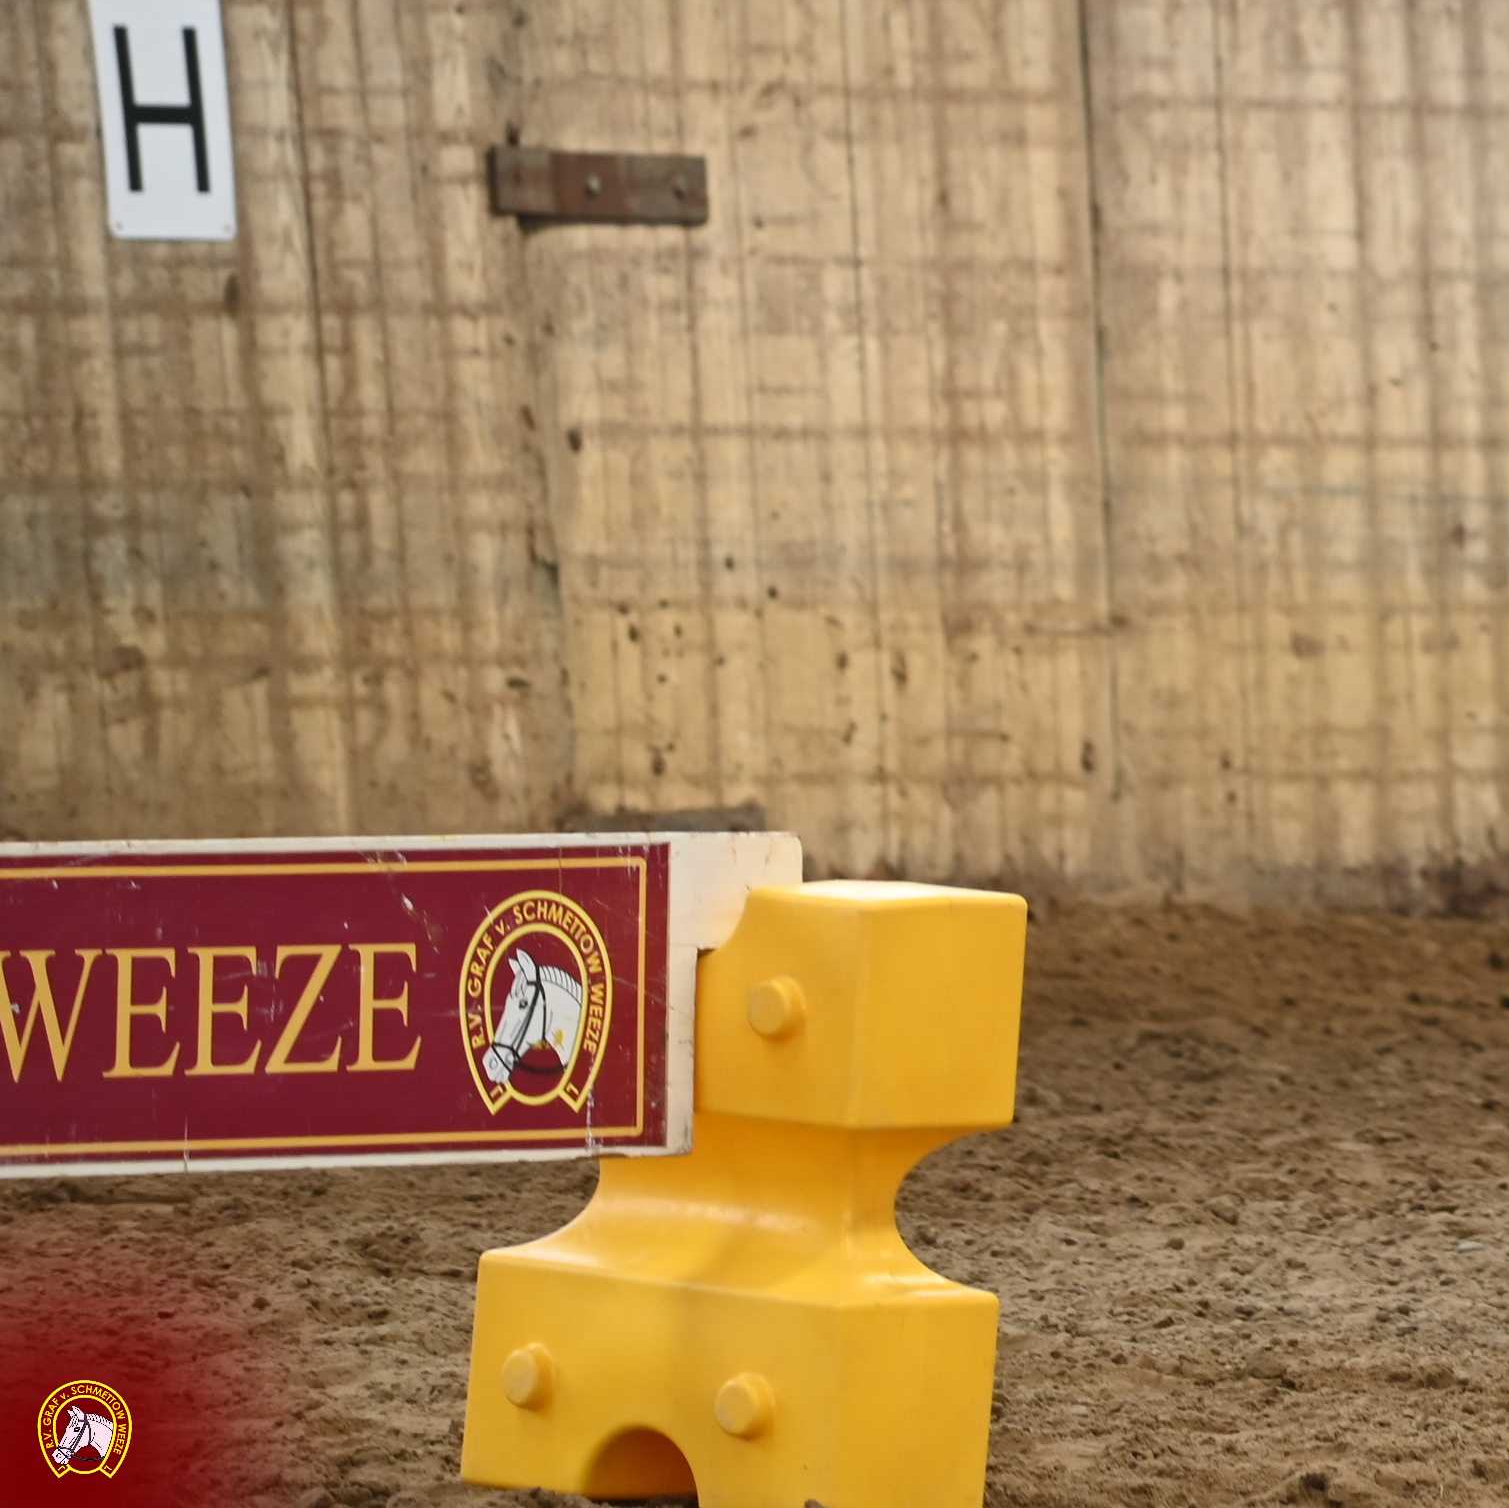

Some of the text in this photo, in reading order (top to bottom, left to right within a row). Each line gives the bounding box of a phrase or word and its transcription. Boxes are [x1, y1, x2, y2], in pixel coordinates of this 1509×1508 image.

[111, 23, 211, 194] H
[0, 943, 421, 1083] WEEZE
[467, 932, 495, 999] GRAF
[512, 899, 603, 974] SCHMETTOW
[582, 983, 606, 1057] WEEZE
